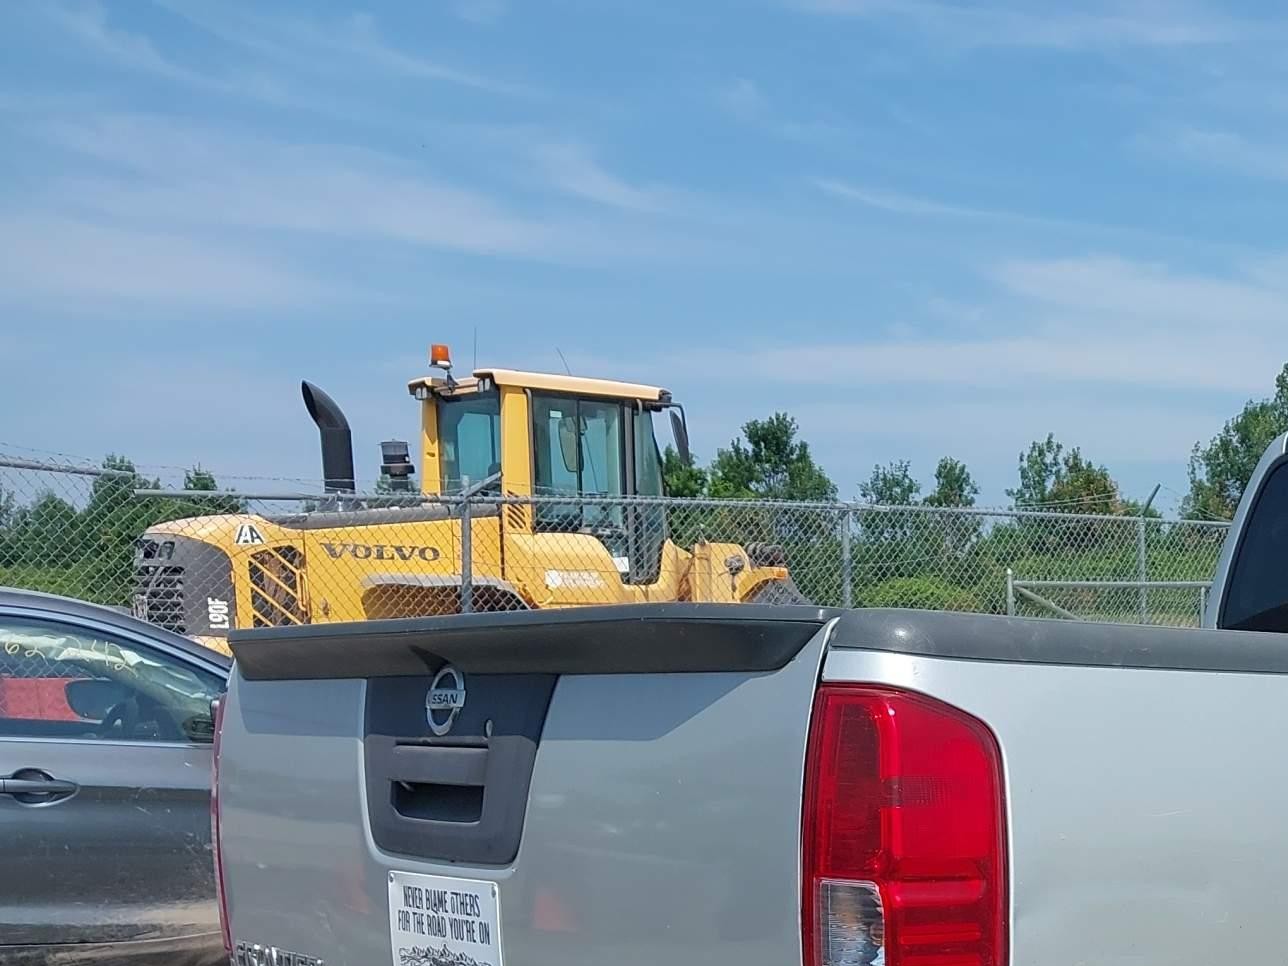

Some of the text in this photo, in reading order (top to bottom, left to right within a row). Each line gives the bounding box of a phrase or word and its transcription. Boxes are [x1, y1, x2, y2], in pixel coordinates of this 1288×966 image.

[320, 542, 440, 562] VOLVO
[208, 597, 229, 629] L90F
[403, 886, 480, 918] NEVER BLAME OTHERS
[398, 910, 490, 945] FOR THE ROAD YOU'RE ON
